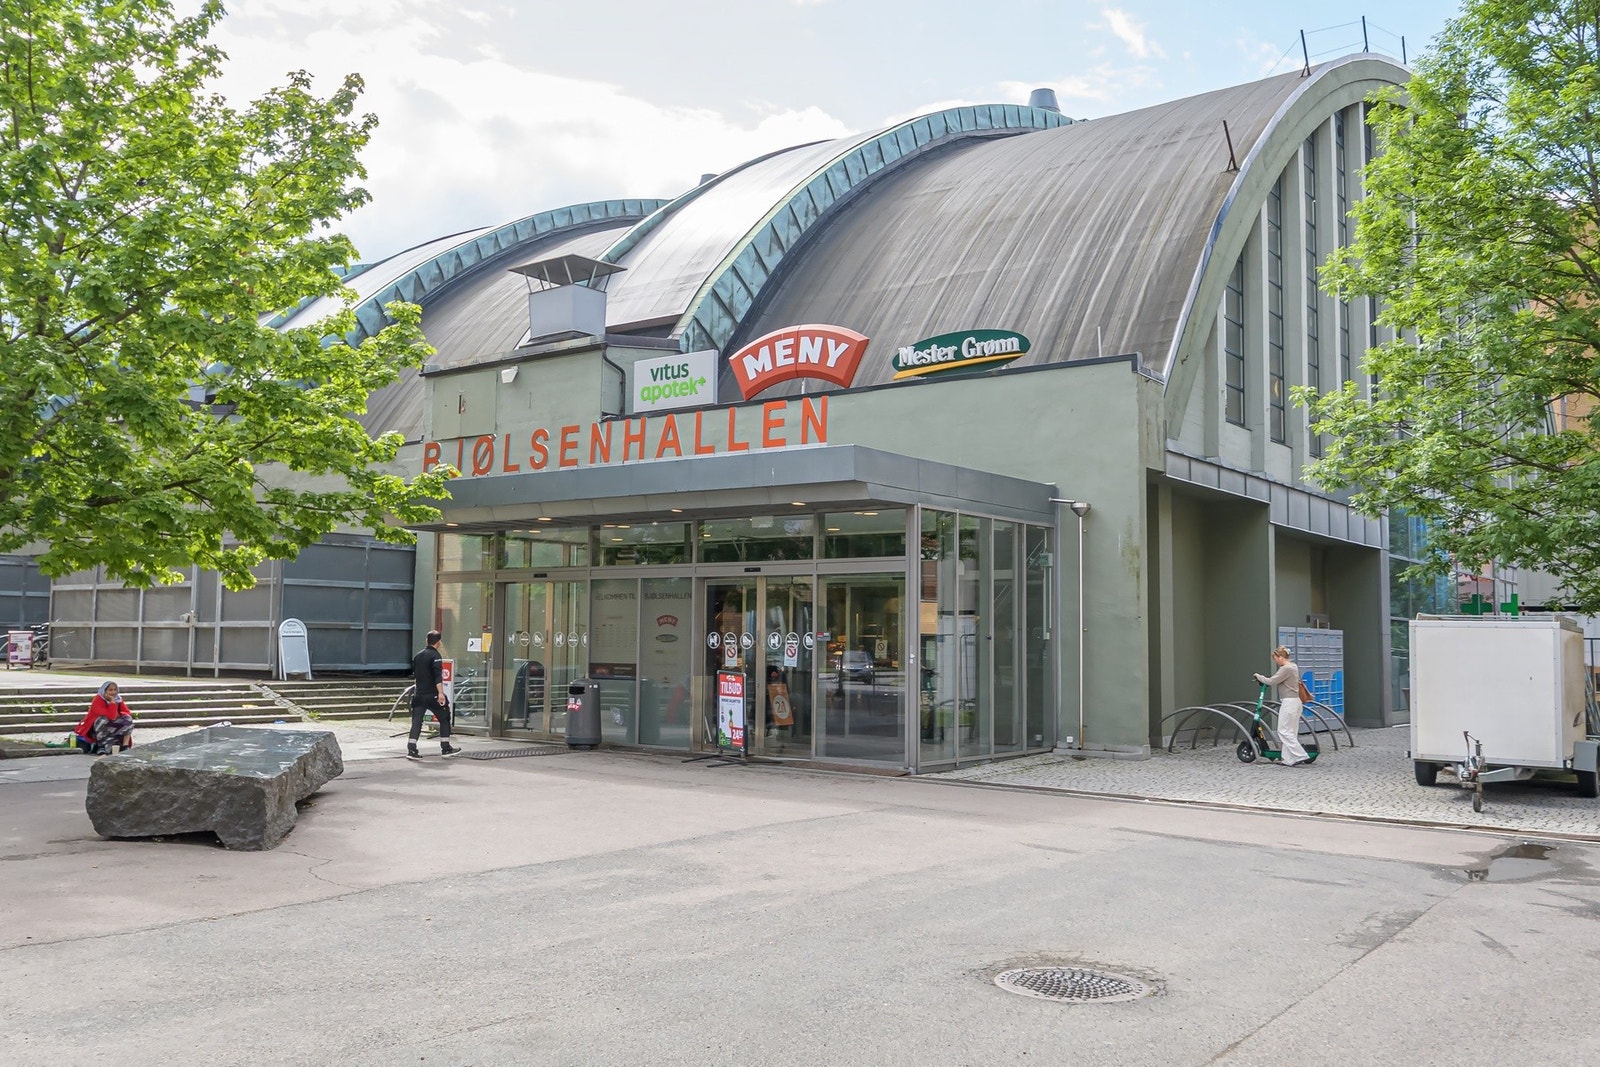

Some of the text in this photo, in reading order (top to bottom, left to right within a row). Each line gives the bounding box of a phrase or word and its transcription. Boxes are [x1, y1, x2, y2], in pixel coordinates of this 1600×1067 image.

[742, 336, 850, 381] MENY
[898, 336, 1020, 367] Mester Grønn
[650, 363, 689, 382] vitus
[423, 395, 828, 478] BJØLSENHALLEN
[720, 681, 742, 695] TILBUD
